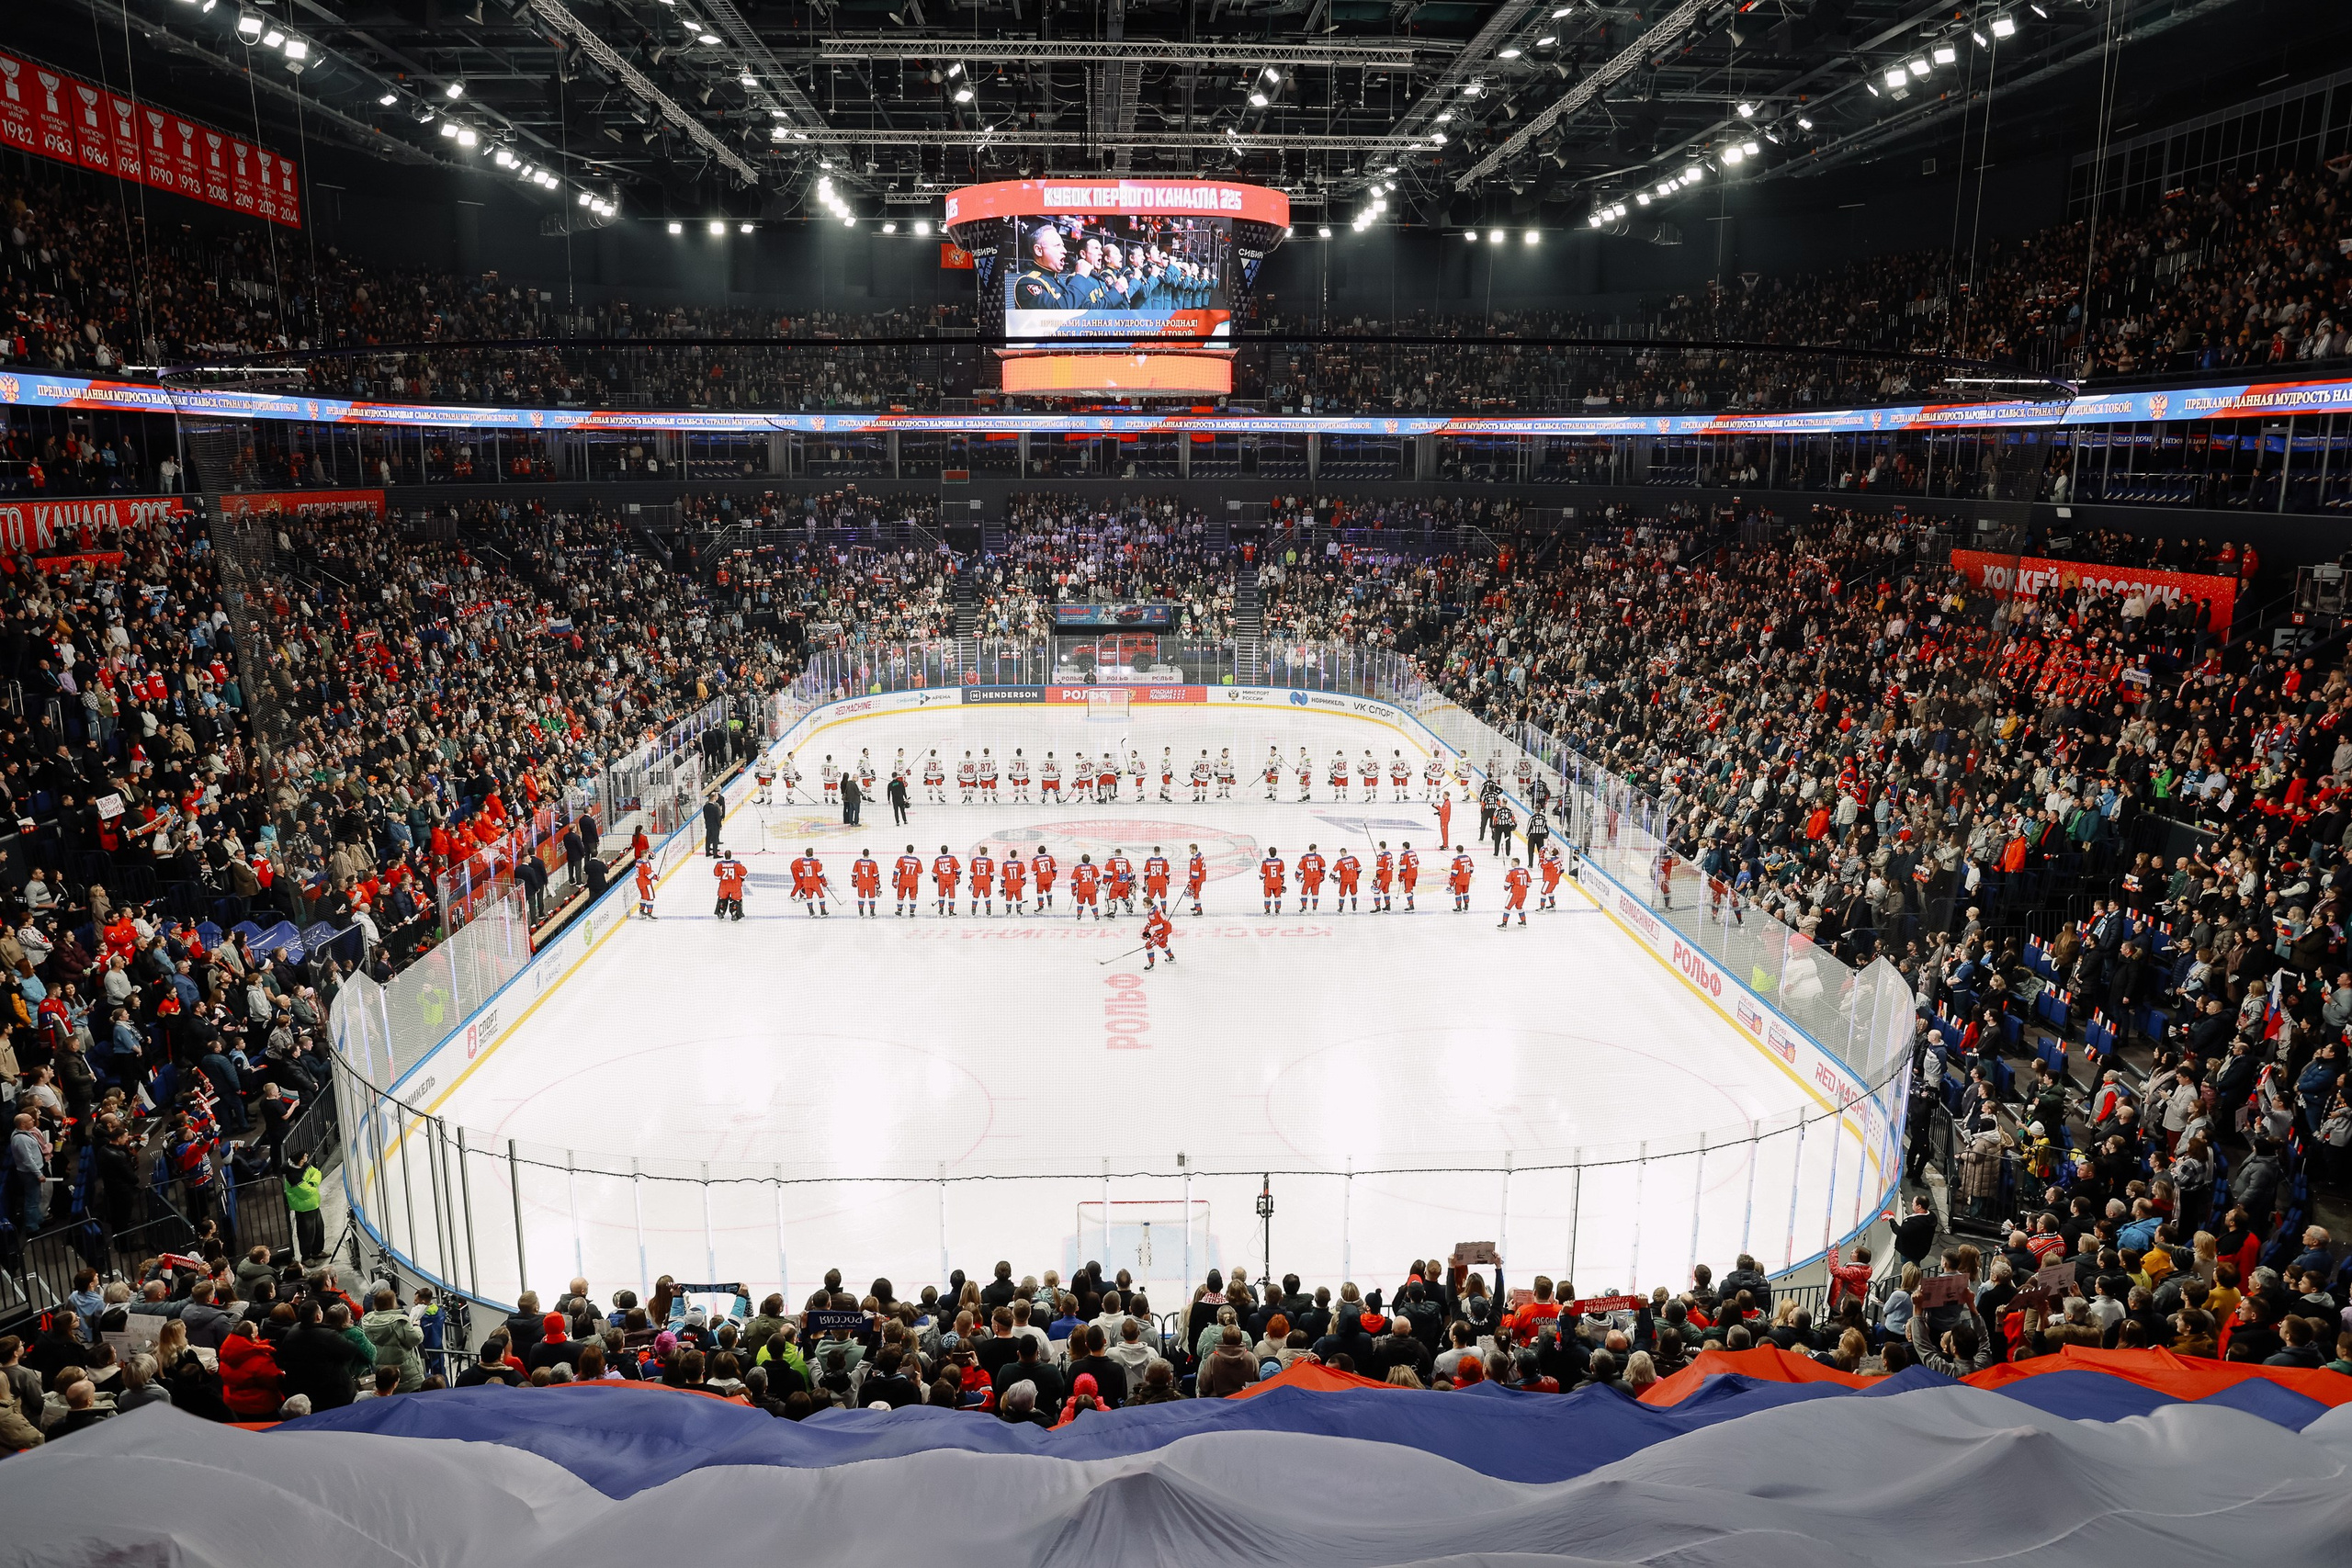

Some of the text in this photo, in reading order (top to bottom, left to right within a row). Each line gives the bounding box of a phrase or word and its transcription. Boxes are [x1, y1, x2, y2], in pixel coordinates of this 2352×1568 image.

[2, 119, 35, 145] 1982
[43, 131, 72, 156] 1983
[81, 144, 108, 167] 1986
[119, 155, 141, 175] 1989
[149, 164, 174, 186] 1990
[178, 174, 201, 195] 1993
[207, 184, 228, 202] 2008
[1044, 186, 1093, 207] КУБОК
[1093, 186, 1155, 208] ПЕРВОГО
[233, 191, 254, 209] 2009
[1114, 320, 1154, 328] МУДРОСТЬ
[37, 384, 82, 399] ПРЕДКАМИ
[82, 388, 114, 402] ДАННАЯ
[114, 389, 151, 404] МУДРОСТЬ
[2185, 389, 2331, 412] ПРЕДКАМИ ДАННАЯ МУДРОСТЬ
[1915, 413, 1937, 423] ДАННАЯ
[1937, 412, 1964, 423] МУДРОСТЬ
[1964, 410, 1996, 421] НАРОДНАЯ!
[1997, 408, 2026, 419] СЛАВЬСЯ,
[2027, 407, 2053, 418] СТРАНА!
[2067, 404, 2104, 415] ГОРДИМСЯ
[2104, 400, 2132, 413] ТОБОЙ!
[555, 415, 584, 424] ПРЕДКАМИ
[584, 416, 608, 424] ДАННАЯ
[641, 417, 676, 425] НАРОДНАЯ!
[676, 418, 705, 426] СЛАВЬСЯ,
[838, 419, 871, 427] ПРЕДКАМИ
[871, 420, 897, 428] ДАННАЯ
[897, 420, 930, 428] МУДРОСТЬ
[966, 420, 994, 428] СЛАВЬСЯ,
[1251, 421, 1281, 429] СЛАВЬСЯ,
[1709, 420, 1782, 429] ДАННАЯ МУДРОСТЬ НАРОДНАЯ!
[1534, 423, 1560, 431] СЛАВЬСЯ,
[845, 700, 873, 715] MACHINE
[1311, 697, 1345, 707] НОРНИКЕЛЬ
[1353, 702, 1367, 711] VK
[1369, 705, 1395, 719] СПОРТ
[823, 766, 831, 777] 11
[928, 762, 937, 772] 13
[963, 764, 974, 773] 88
[980, 762, 990, 772] 87
[1015, 762, 1025, 772] 71
[1045, 762, 1055, 772] 34
[1199, 763, 1210, 773] 93
[1337, 761, 1347, 771] 68
[1367, 762, 1378, 771] 23
[1431, 763, 1442, 772] 22
[803, 865, 812, 877] 10
[862, 867, 869, 878] 4
[904, 863, 917, 874] 77
[938, 862, 951, 874] 45
[976, 863, 987, 876] 13
[1038, 861, 1051, 873] 87
[1115, 862, 1127, 874] 99
[1150, 865, 1163, 876] 89
[1270, 867, 1277, 878] 6
[1306, 860, 1318, 873] 44
[1461, 862, 1470, 874] 76
[721, 867, 735, 880] 29
[1009, 868, 1018, 880] 11
[1080, 871, 1092, 882] 34
[1672, 940, 1722, 998] РОЛЬФ
[1104, 974, 1153, 1049] РОЛЬФ
[478, 1009, 498, 1037] СПОРТ
[1815, 1062, 1872, 1124] RED MACHI
[391, 1075, 435, 1125] ННИКЕЛЬ
[1584, 1296, 1622, 1306] КРАСНАЯ
[1584, 1302, 1630, 1314] МАШИНА
[820, 1314, 863, 1325] РОССИЯ
